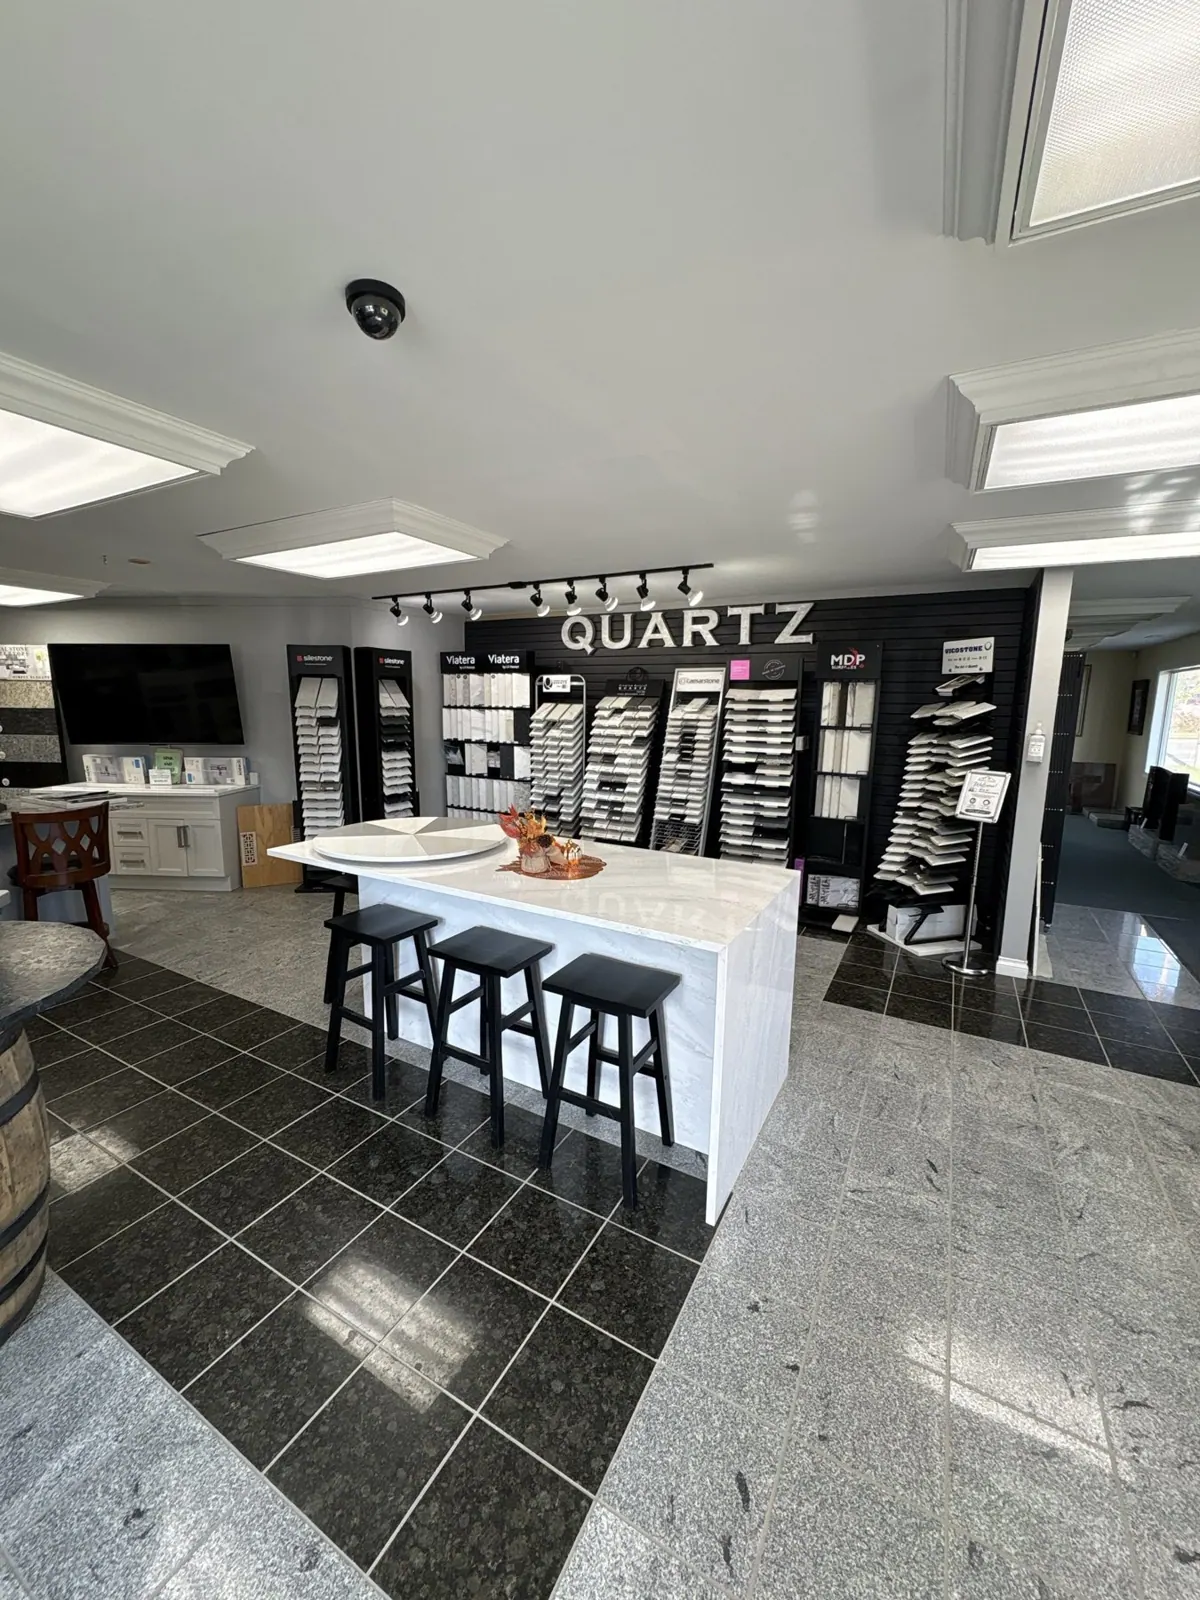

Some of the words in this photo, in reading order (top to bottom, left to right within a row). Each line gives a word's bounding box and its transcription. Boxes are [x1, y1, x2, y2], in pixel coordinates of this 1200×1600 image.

[560, 602, 815, 656] QUARTZ
[944, 645, 983, 654] VICOSTONE
[303, 654, 333, 662] silestone
[383, 657, 405, 665] silestone
[446, 655, 476, 665] Viatera
[487, 654, 520, 664] Viatera
[830, 654, 866, 666] MDP
